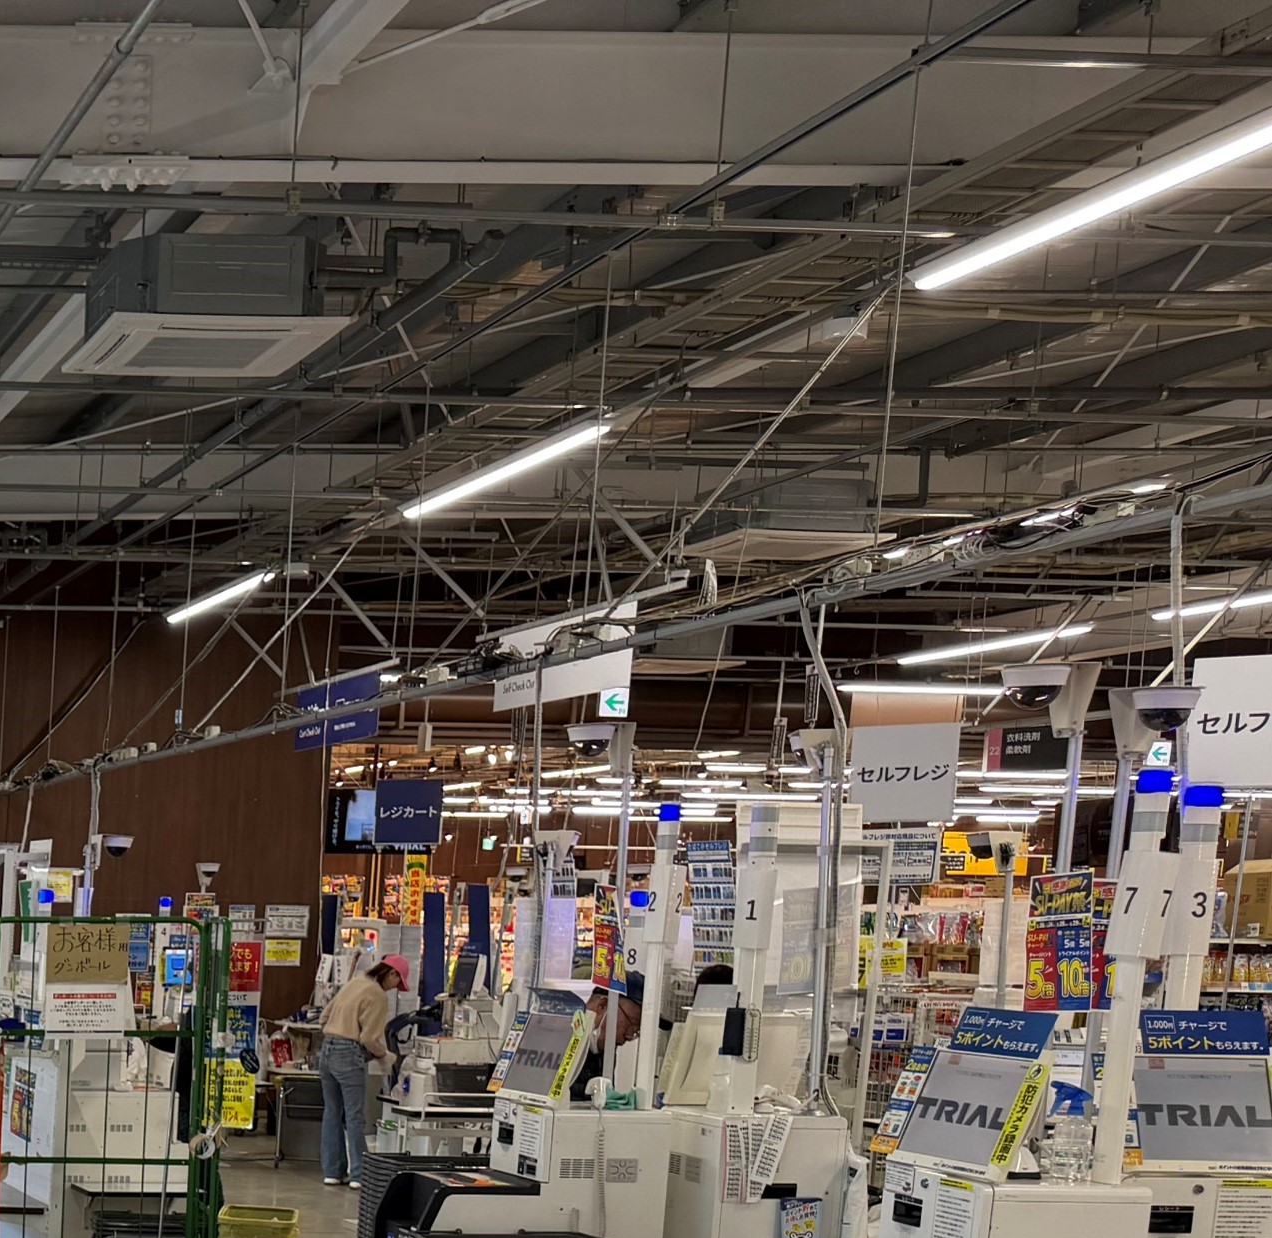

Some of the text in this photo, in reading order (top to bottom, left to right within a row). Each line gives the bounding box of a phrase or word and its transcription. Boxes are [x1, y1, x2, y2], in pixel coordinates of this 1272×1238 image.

[1196, 711, 1271, 735] セルフ
[1006, 731, 1041, 743] 衣料洗剤
[989, 746, 1001, 756] 22
[1005, 744, 1032, 755] 柔軟剤
[856, 763, 950, 784] セルフレジ
[379, 806, 438, 819] レジカート
[745, 899, 757, 921] 1
[1123, 886, 1208, 918] 7 7 3
[626, 947, 637, 966] 8
[1025, 958, 1055, 999] 5倍
[1057, 957, 1092, 998] 10倍
[987, 1017, 1026, 1030] チャージで
[1178, 1021, 1227, 1031] チャージで
[954, 1031, 1039, 1053] 5ポイントもらえます。
[1148, 1036, 1264, 1050] 5ポイントもらえます。
[916, 1096, 1006, 1131] TRIAL
[995, 1083, 1039, 1164] 防犯カメラ録画中
[1136, 1103, 1272, 1128] TRIAL
